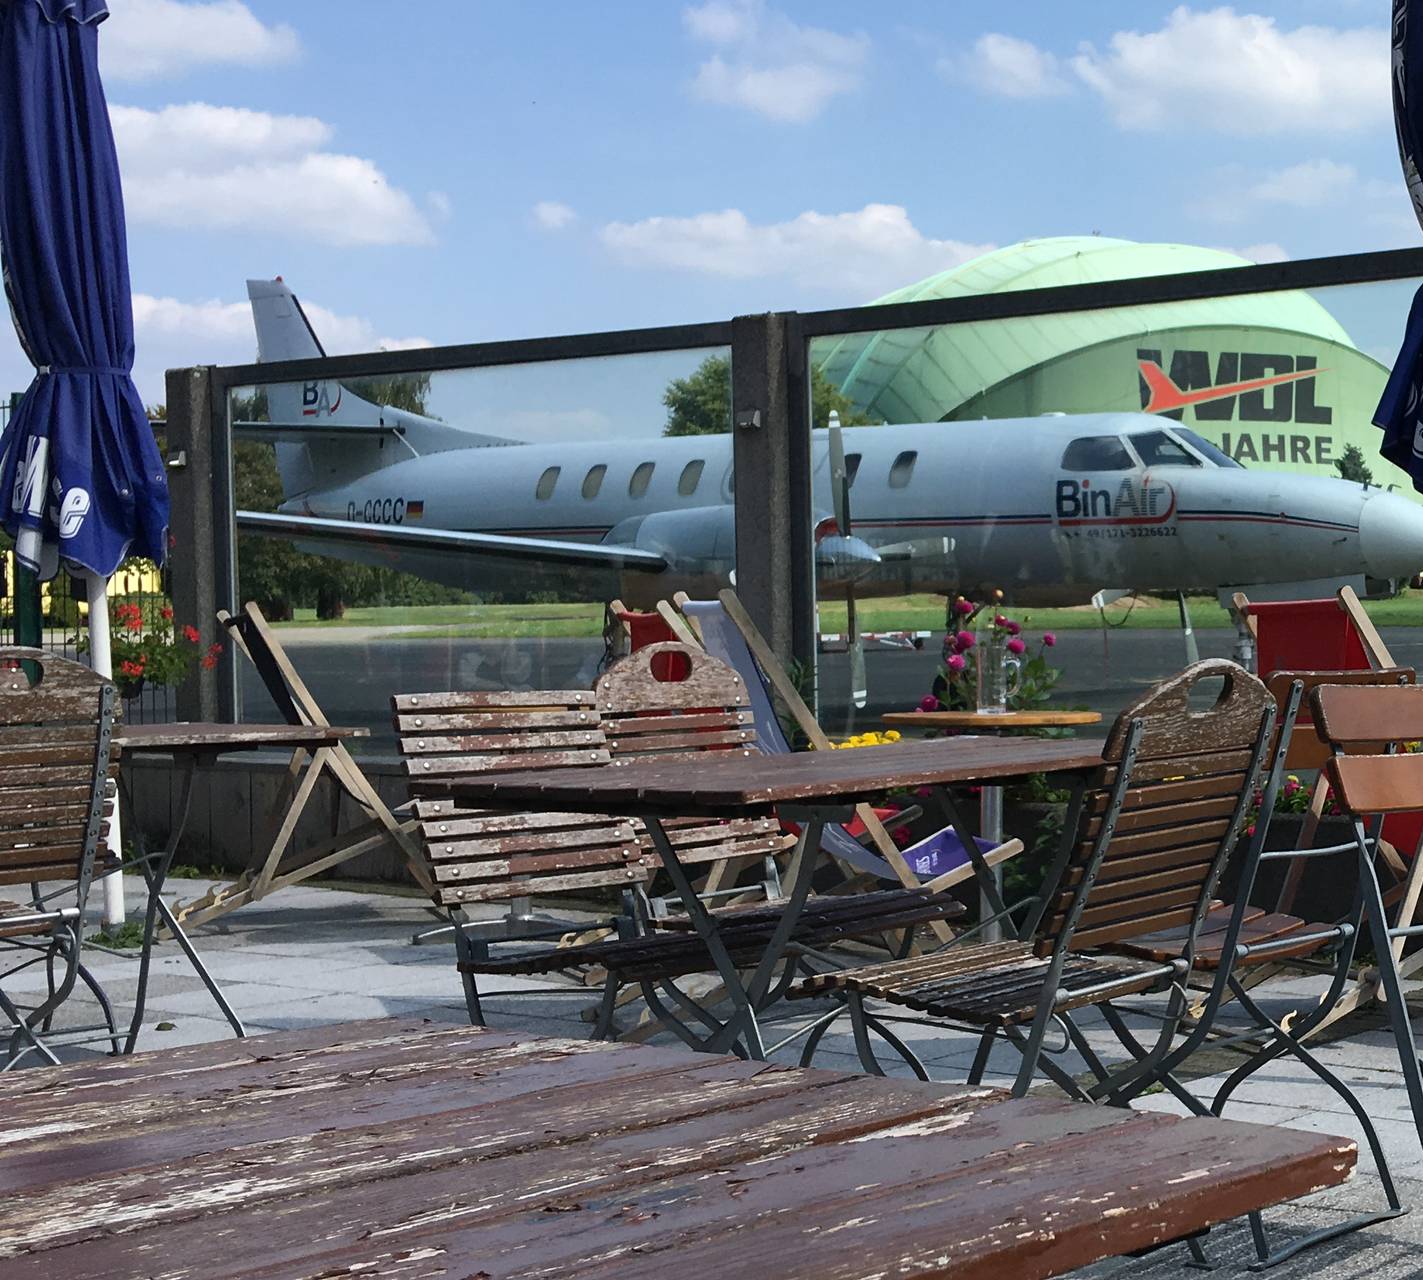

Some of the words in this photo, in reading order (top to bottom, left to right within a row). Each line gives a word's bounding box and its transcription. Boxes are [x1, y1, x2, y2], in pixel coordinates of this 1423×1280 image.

[1137, 349, 1332, 424] WDL
[1222, 433, 1333, 464] JAHRE
[1056, 476, 1165, 518] BinAir
